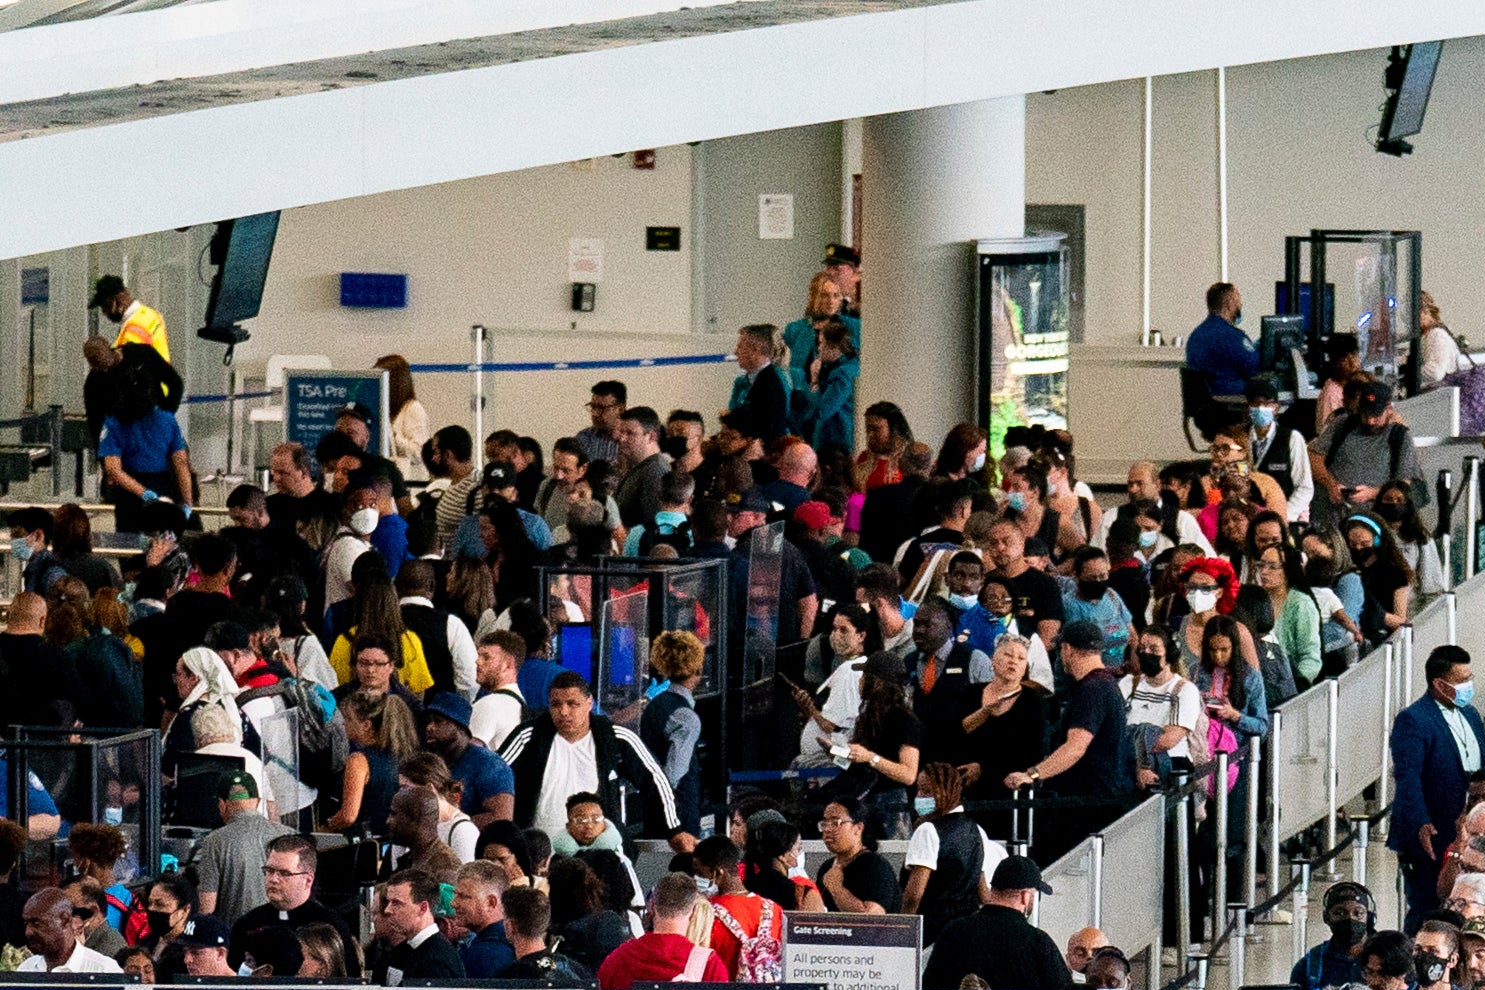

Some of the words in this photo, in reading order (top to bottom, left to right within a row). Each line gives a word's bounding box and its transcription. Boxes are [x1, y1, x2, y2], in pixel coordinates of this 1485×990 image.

[298, 384, 323, 398] TSA
[325, 384, 347, 398] Pre
[794, 926, 811, 935] Gate
[813, 926, 853, 937] Screening
[793, 953, 807, 963] All
[810, 954, 851, 966] persons
[854, 954, 874, 966] and
[793, 968, 840, 979] property
[842, 971, 866, 981] may
[869, 969, 882, 980] be
